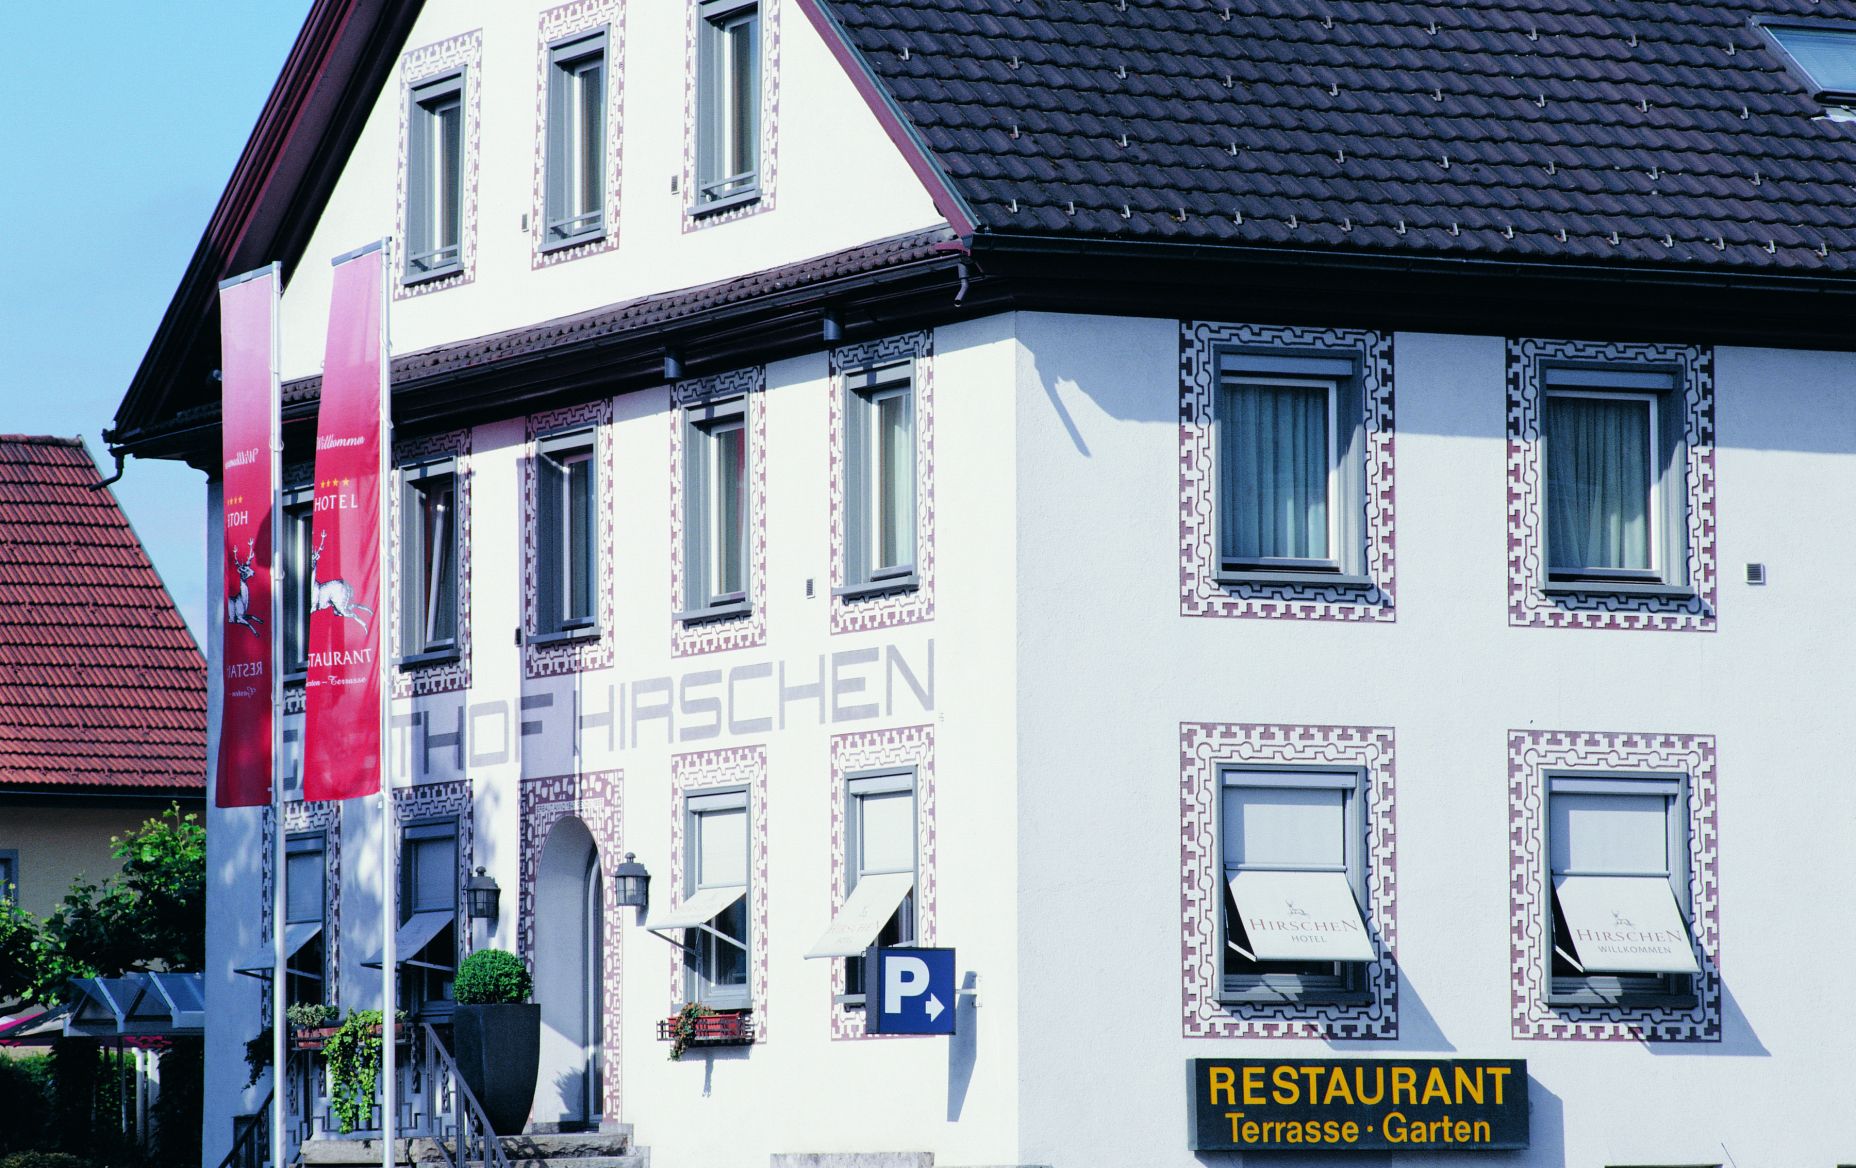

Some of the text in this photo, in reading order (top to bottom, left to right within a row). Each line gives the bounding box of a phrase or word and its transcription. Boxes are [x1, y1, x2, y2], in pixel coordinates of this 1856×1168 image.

[314, 494, 358, 512] HOTEL
[308, 648, 372, 668] TAURANT
[573, 638, 935, 757] HIRSCHEN
[1249, 918, 1359, 932] HIRSCHEN
[1291, 935, 1328, 943] HOTEL
[1576, 929, 1682, 943] HIRSCHEN
[1598, 946, 1672, 954] WILLKOMMEN
[884, 956, 930, 1014] P
[1209, 1065, 1512, 1105] RESTAURANT
[1225, 1112, 1360, 1143] Terrasse
[1382, 1111, 1491, 1144] Garten
